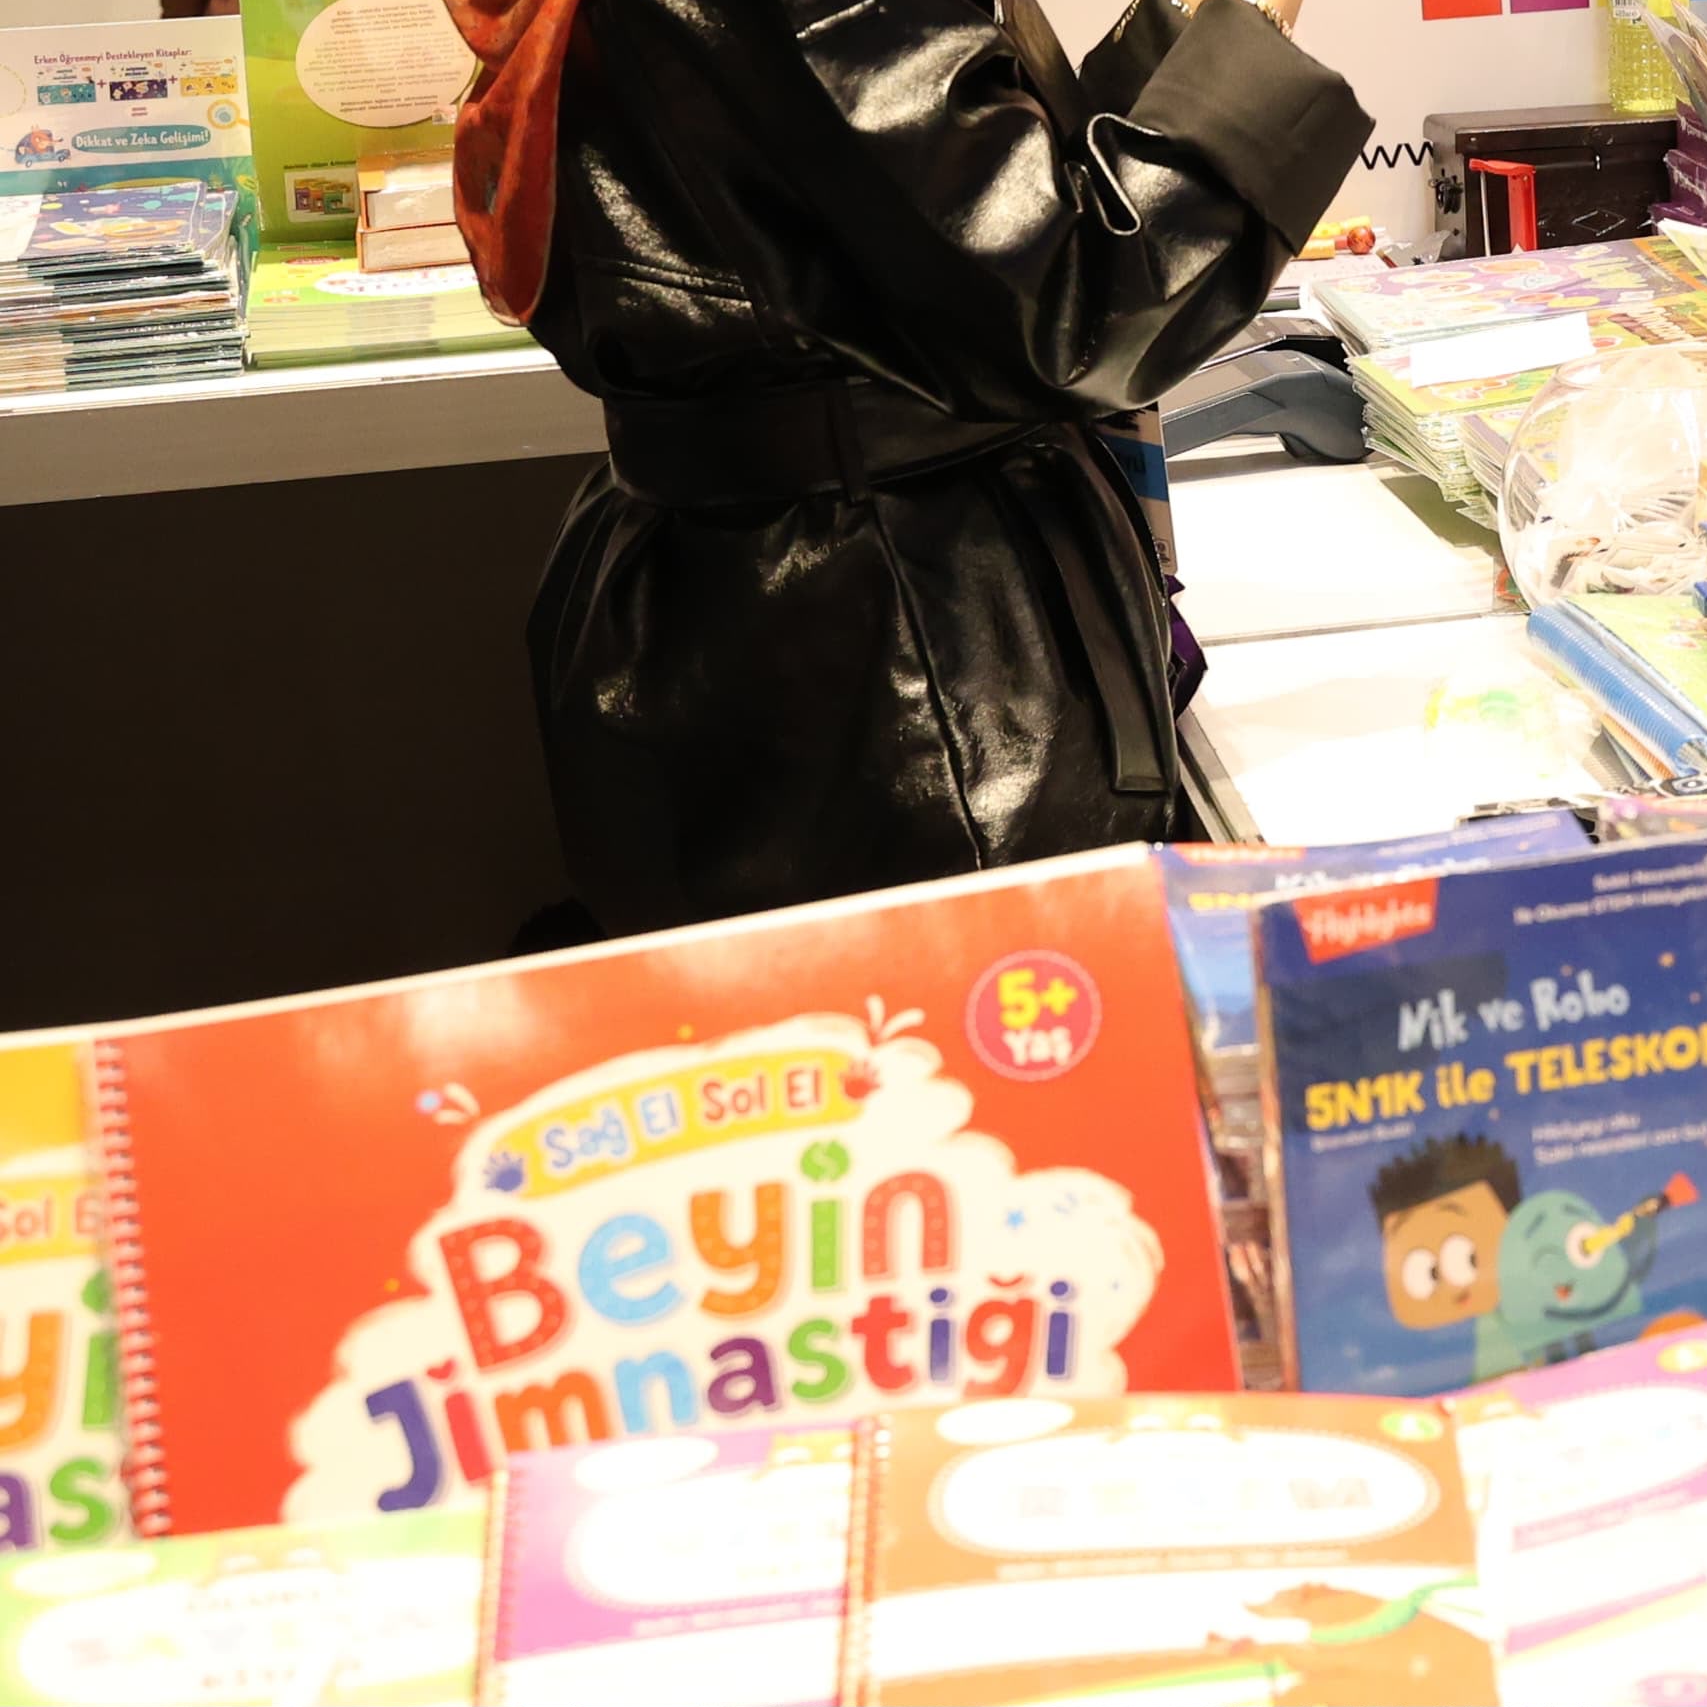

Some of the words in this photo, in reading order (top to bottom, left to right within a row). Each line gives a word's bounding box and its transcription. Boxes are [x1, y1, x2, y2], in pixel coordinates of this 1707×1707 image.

[34, 55, 58, 65] Erken
[76, 134, 113, 148] Dikkat
[115, 138, 129, 146] ve
[130, 133, 158, 146] Zeka
[160, 131, 209, 148] Gelişimi!
[1303, 897, 1434, 945] Highlights
[998, 970, 1078, 1030] 5+
[1478, 1000, 1524, 1033] ve
[1530, 968, 1630, 1031] Robo
[1001, 1026, 1073, 1067] Yaş
[545, 1105, 630, 1171] Sağ
[640, 1093, 677, 1136] El
[702, 1075, 768, 1124] Sol
[785, 1068, 823, 1109] El
[1305, 1070, 1425, 1132] 5N1K
[1435, 1062, 1496, 1109] ile
[439, 1139, 956, 1373] Beyin
[365, 1278, 1074, 1514] Jimnastiği
